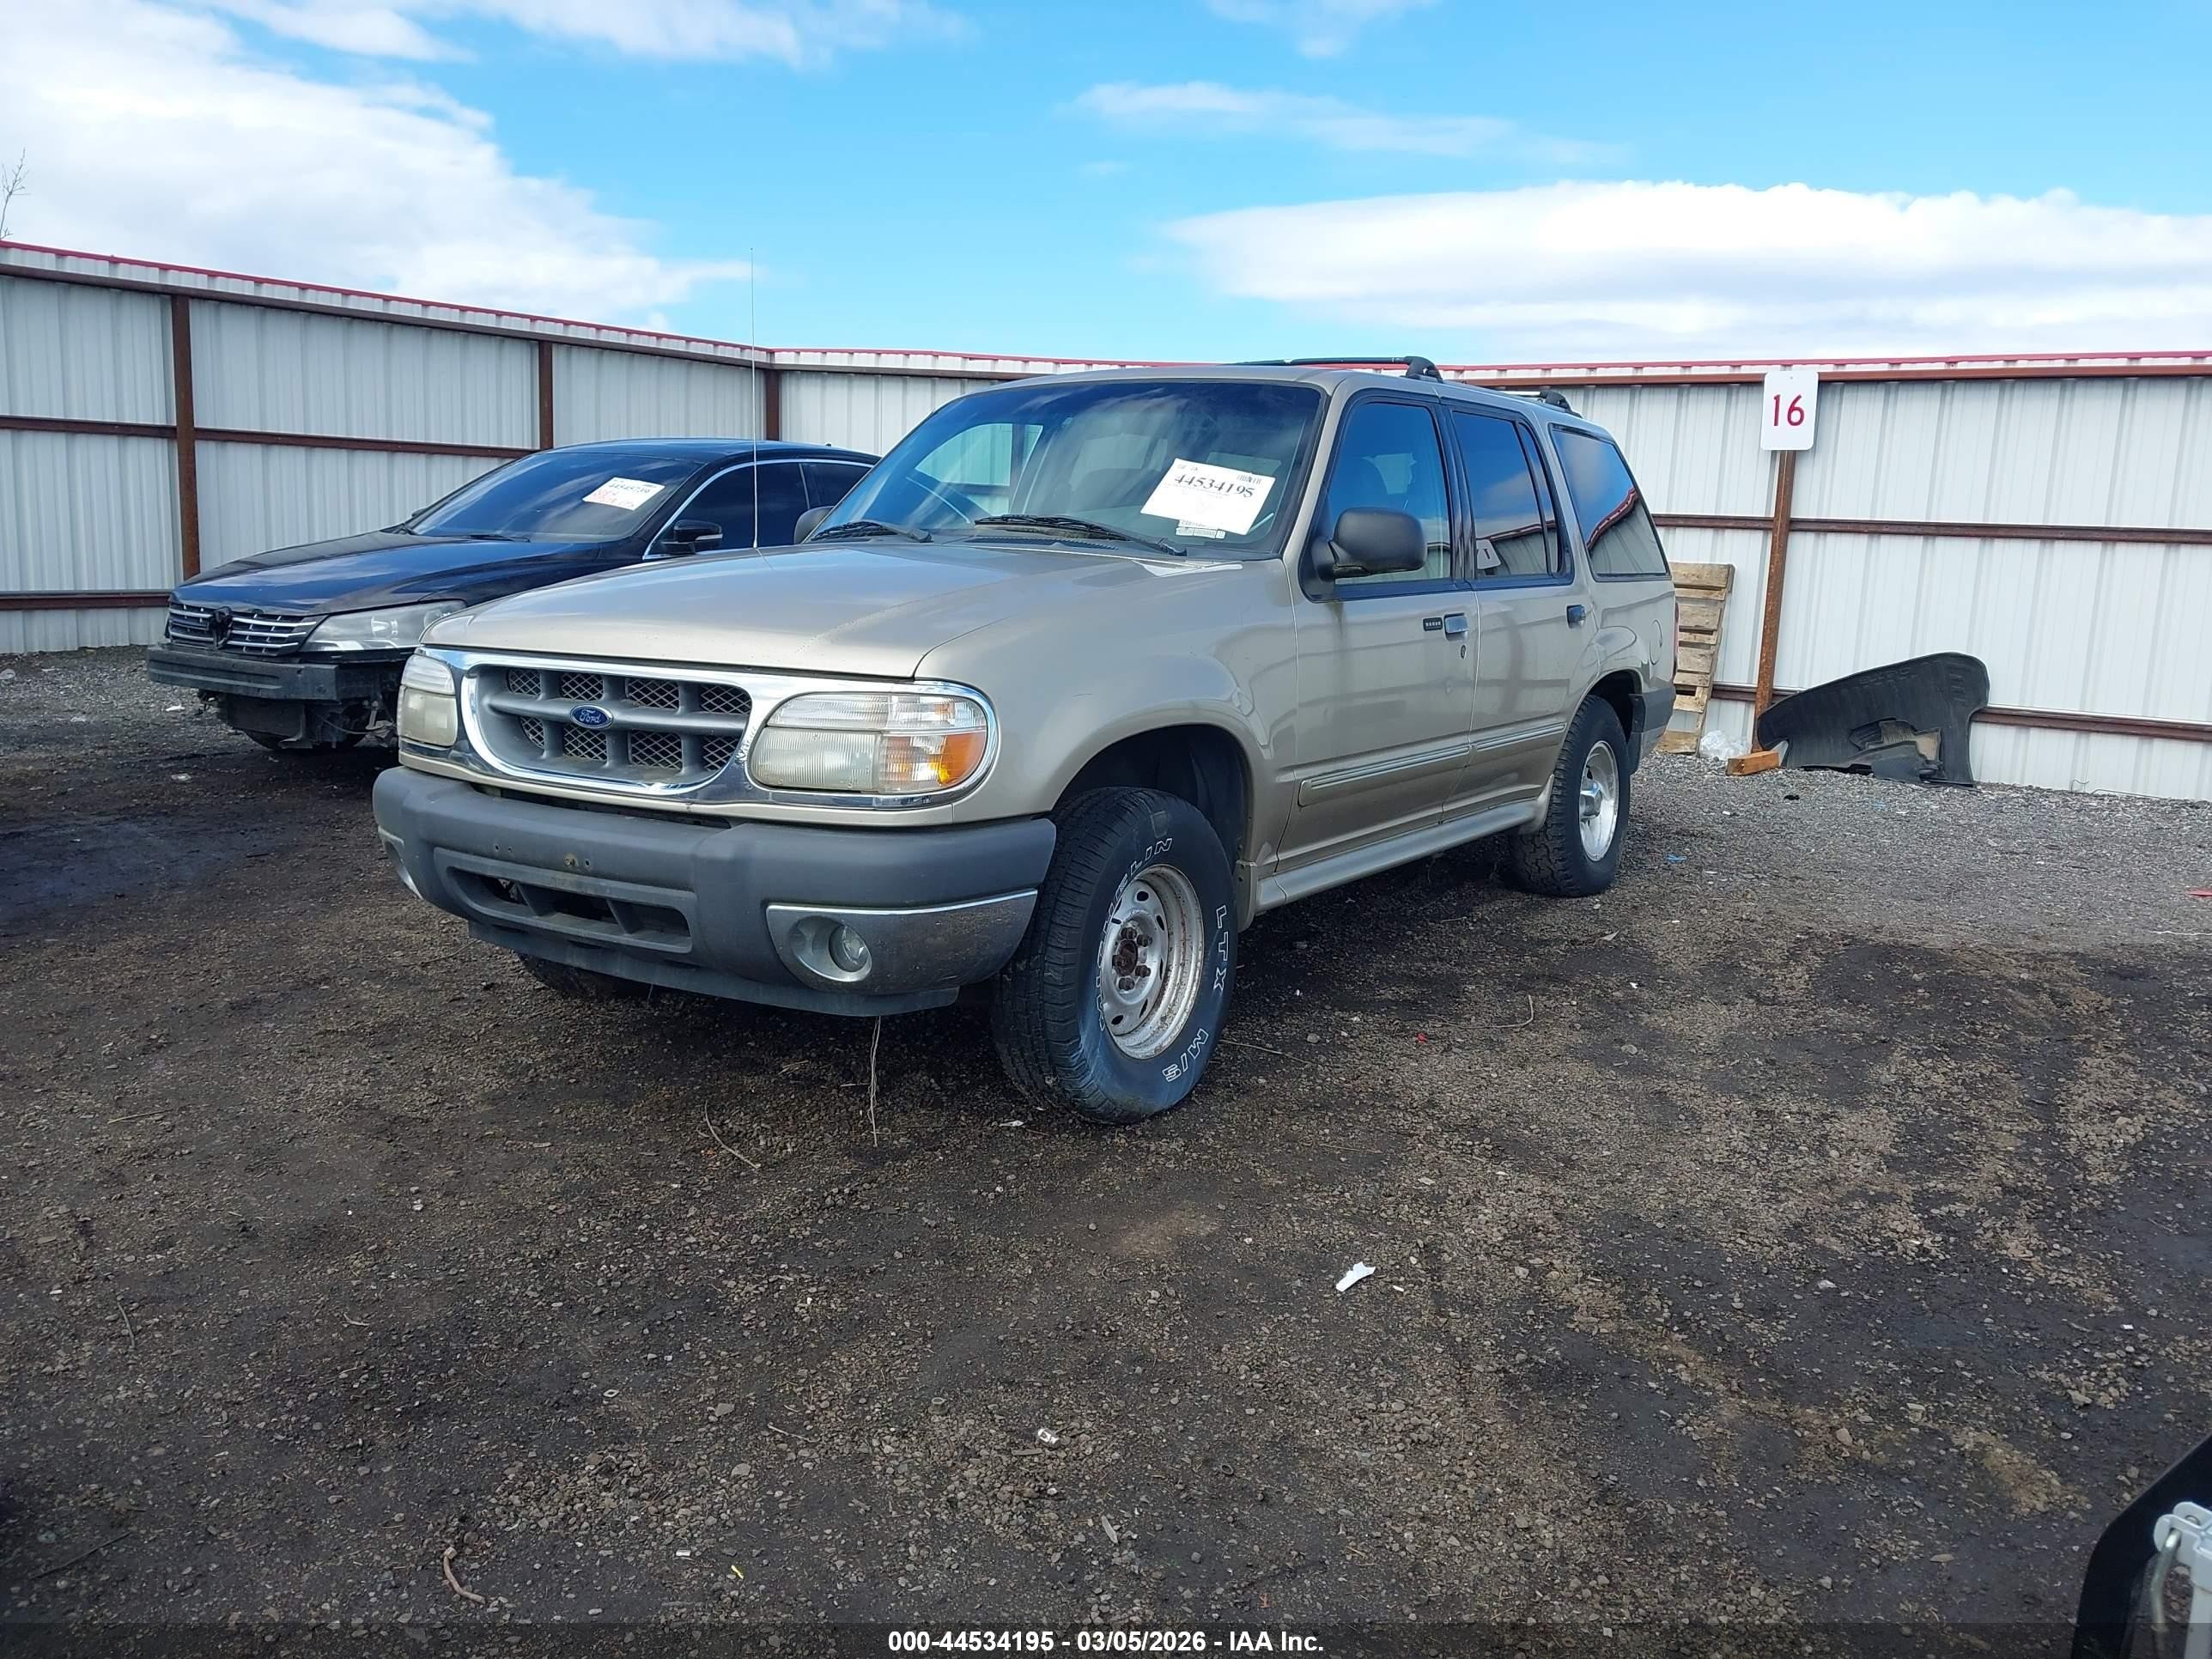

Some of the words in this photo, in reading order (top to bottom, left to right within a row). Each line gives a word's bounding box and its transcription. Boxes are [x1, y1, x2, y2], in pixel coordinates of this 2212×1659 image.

[1773, 393, 1805, 427] 16
[1174, 473, 1256, 498] 44534195
[579, 708, 601, 723] Ford
[1212, 905, 1229, 992] LTX
